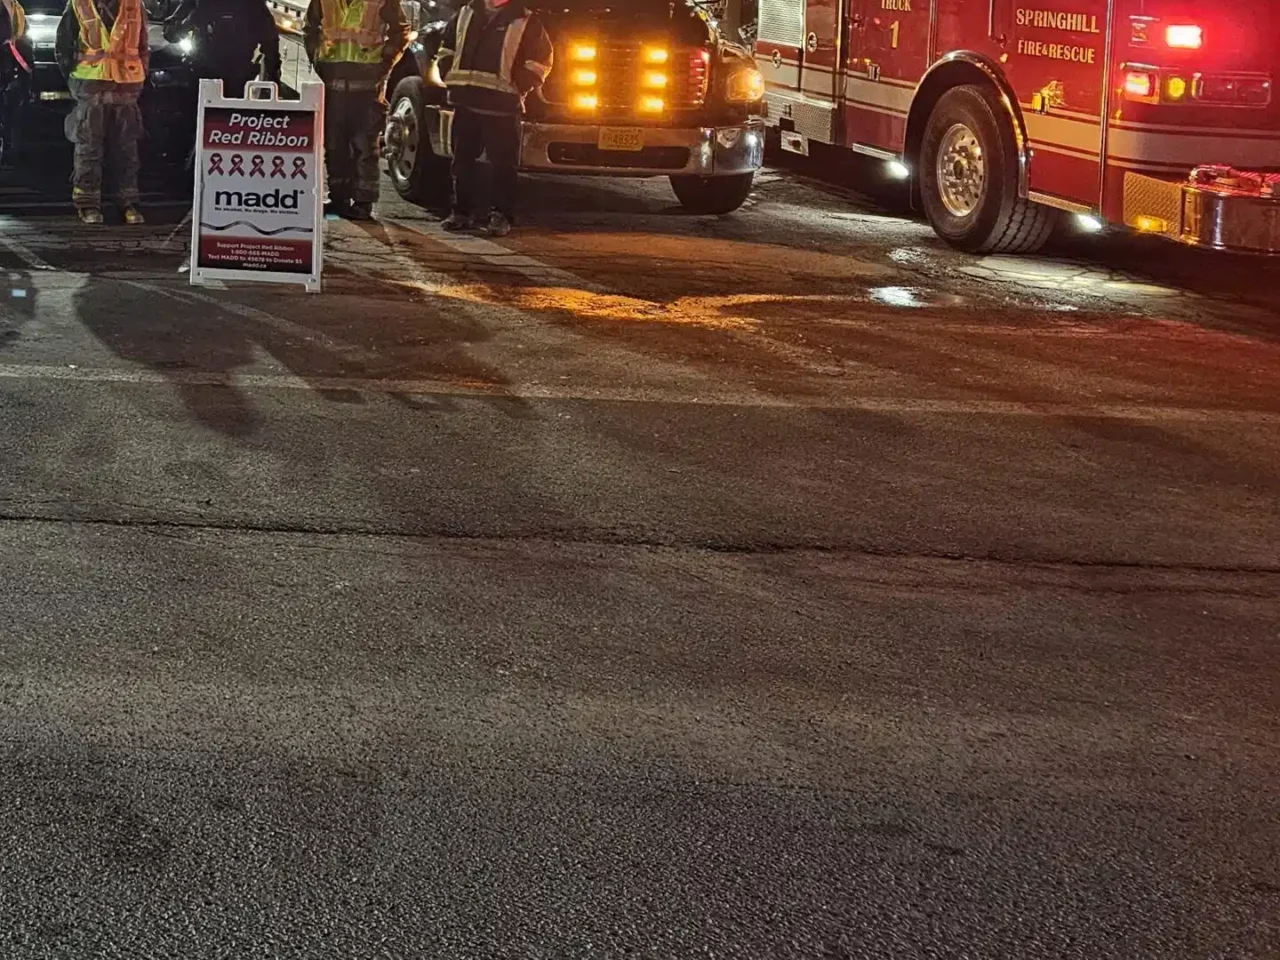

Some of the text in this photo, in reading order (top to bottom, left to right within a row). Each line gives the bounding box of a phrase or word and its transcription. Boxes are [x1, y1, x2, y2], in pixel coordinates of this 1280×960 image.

[1016, 8, 1100, 33] SPRINGHILL
[890, 20, 900, 48] 1
[229, 113, 290, 130] Project
[208, 130, 309, 147] Red Ribbon
[214, 188, 299, 209] madd
